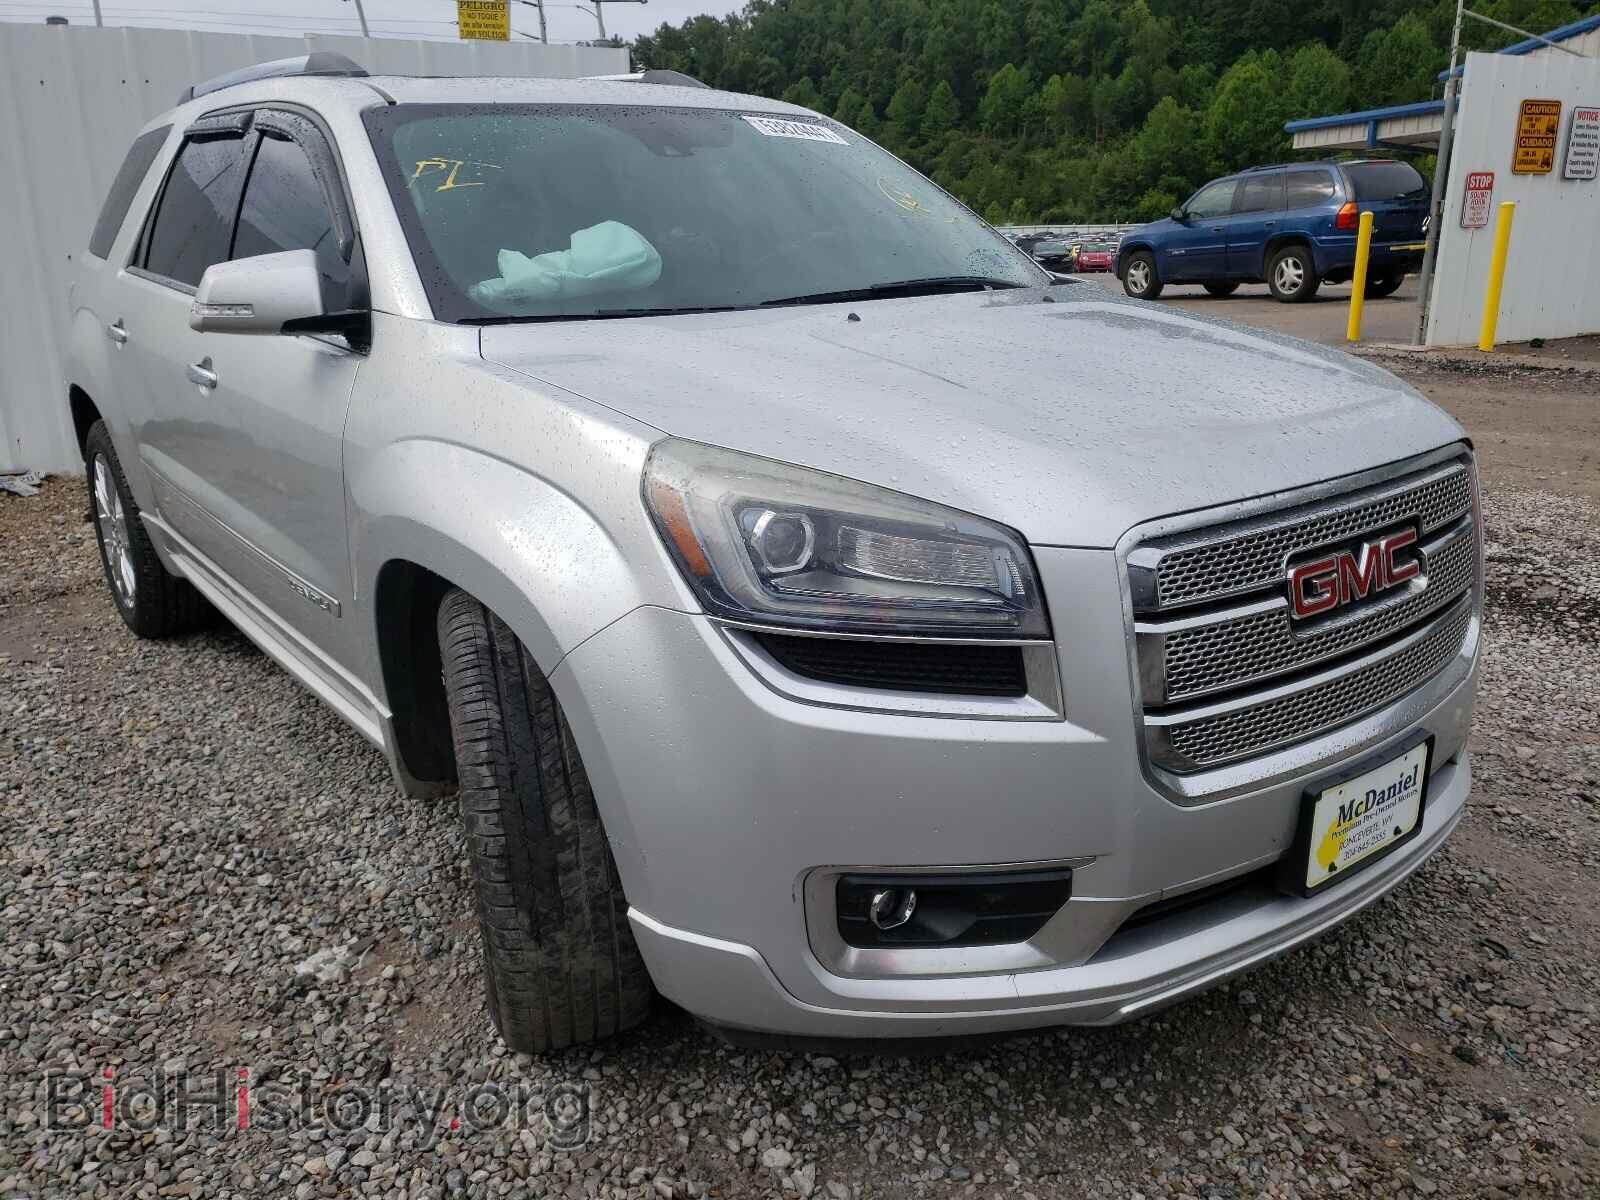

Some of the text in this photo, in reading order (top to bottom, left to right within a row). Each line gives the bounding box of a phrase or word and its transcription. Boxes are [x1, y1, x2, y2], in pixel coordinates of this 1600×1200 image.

[460, 1, 505, 10] PELIGRO
[1525, 104, 1559, 115] CAUTION
[1576, 111, 1600, 122] NOTICE
[1520, 138, 1553, 147] CUIDADO
[1469, 176, 1492, 189] STOP
[1288, 527, 1420, 620] GMC
[1337, 764, 1418, 827] McDaniel
[1331, 819, 1362, 840] Premium
[1363, 800, 1397, 823] Pre-Owned
